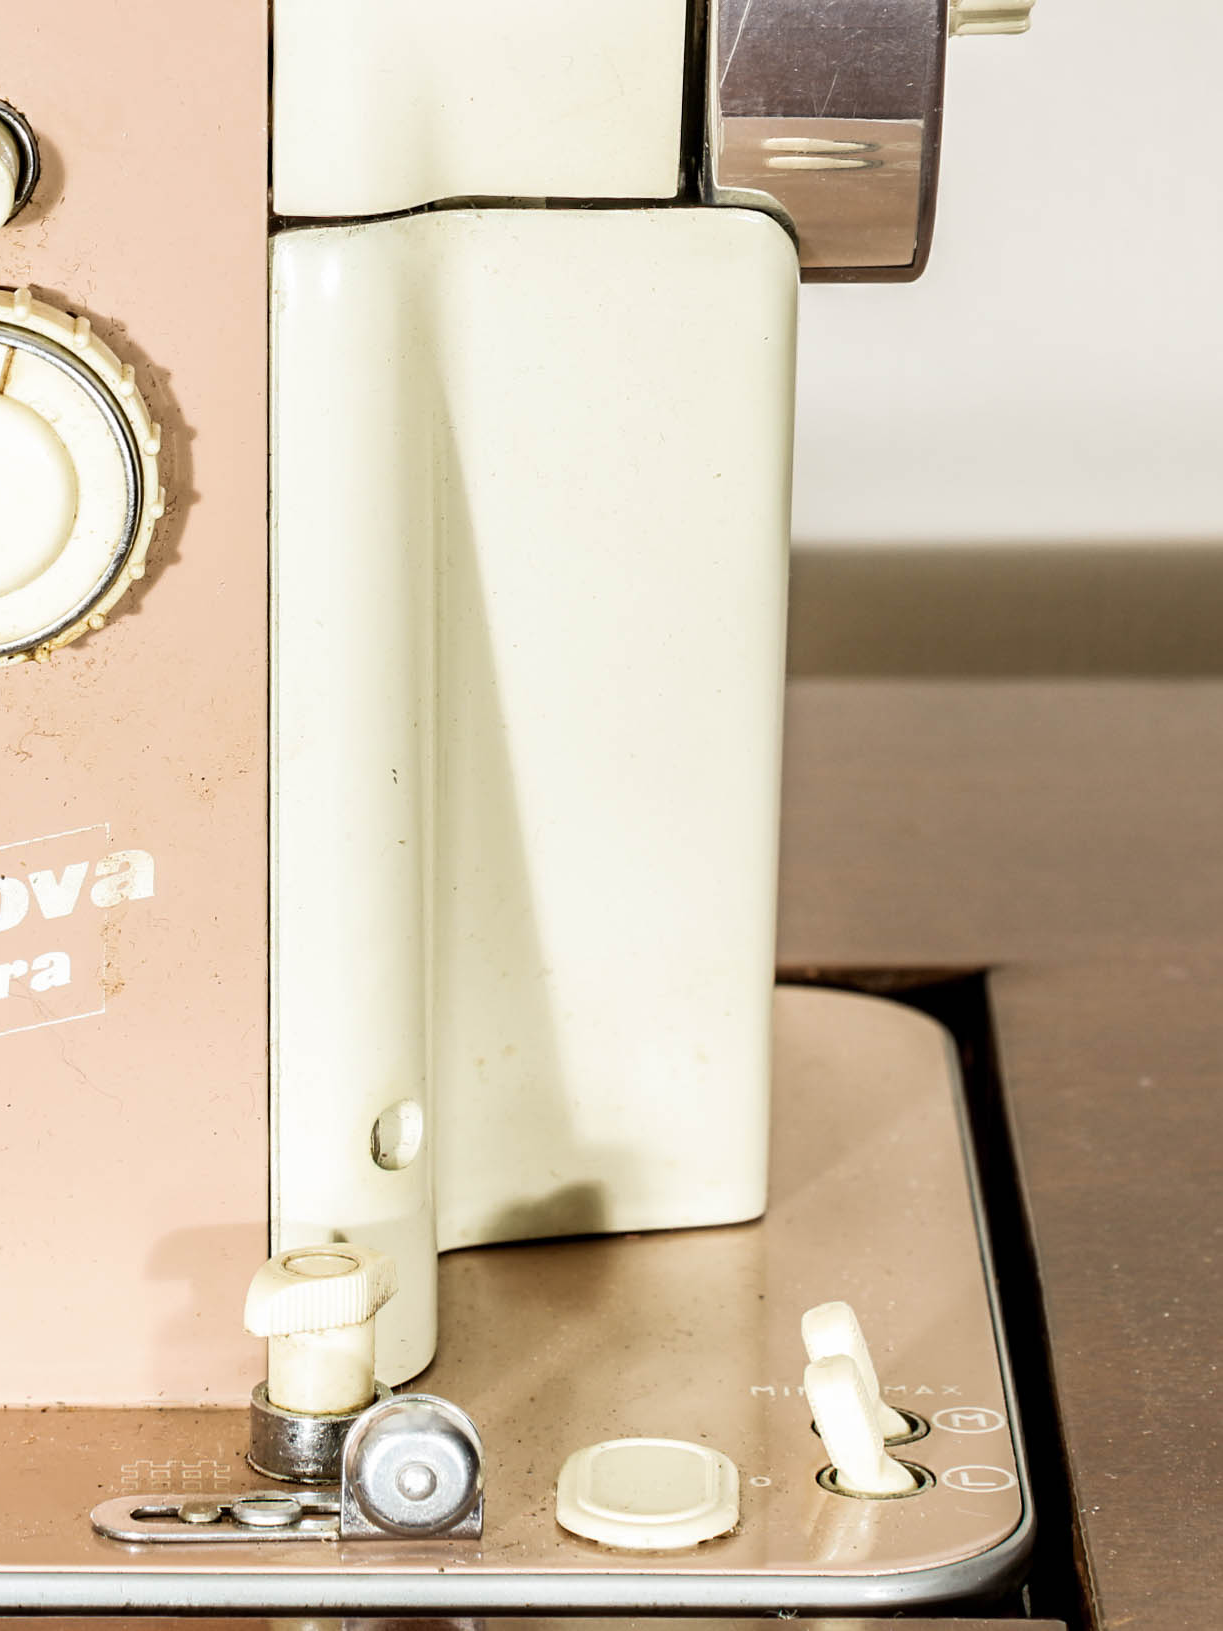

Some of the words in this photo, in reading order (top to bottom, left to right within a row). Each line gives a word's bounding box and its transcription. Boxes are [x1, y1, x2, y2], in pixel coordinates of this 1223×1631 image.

[884, 1385, 962, 1396] MAX
[950, 1413, 986, 1427] M
[960, 1471, 997, 1486] L
